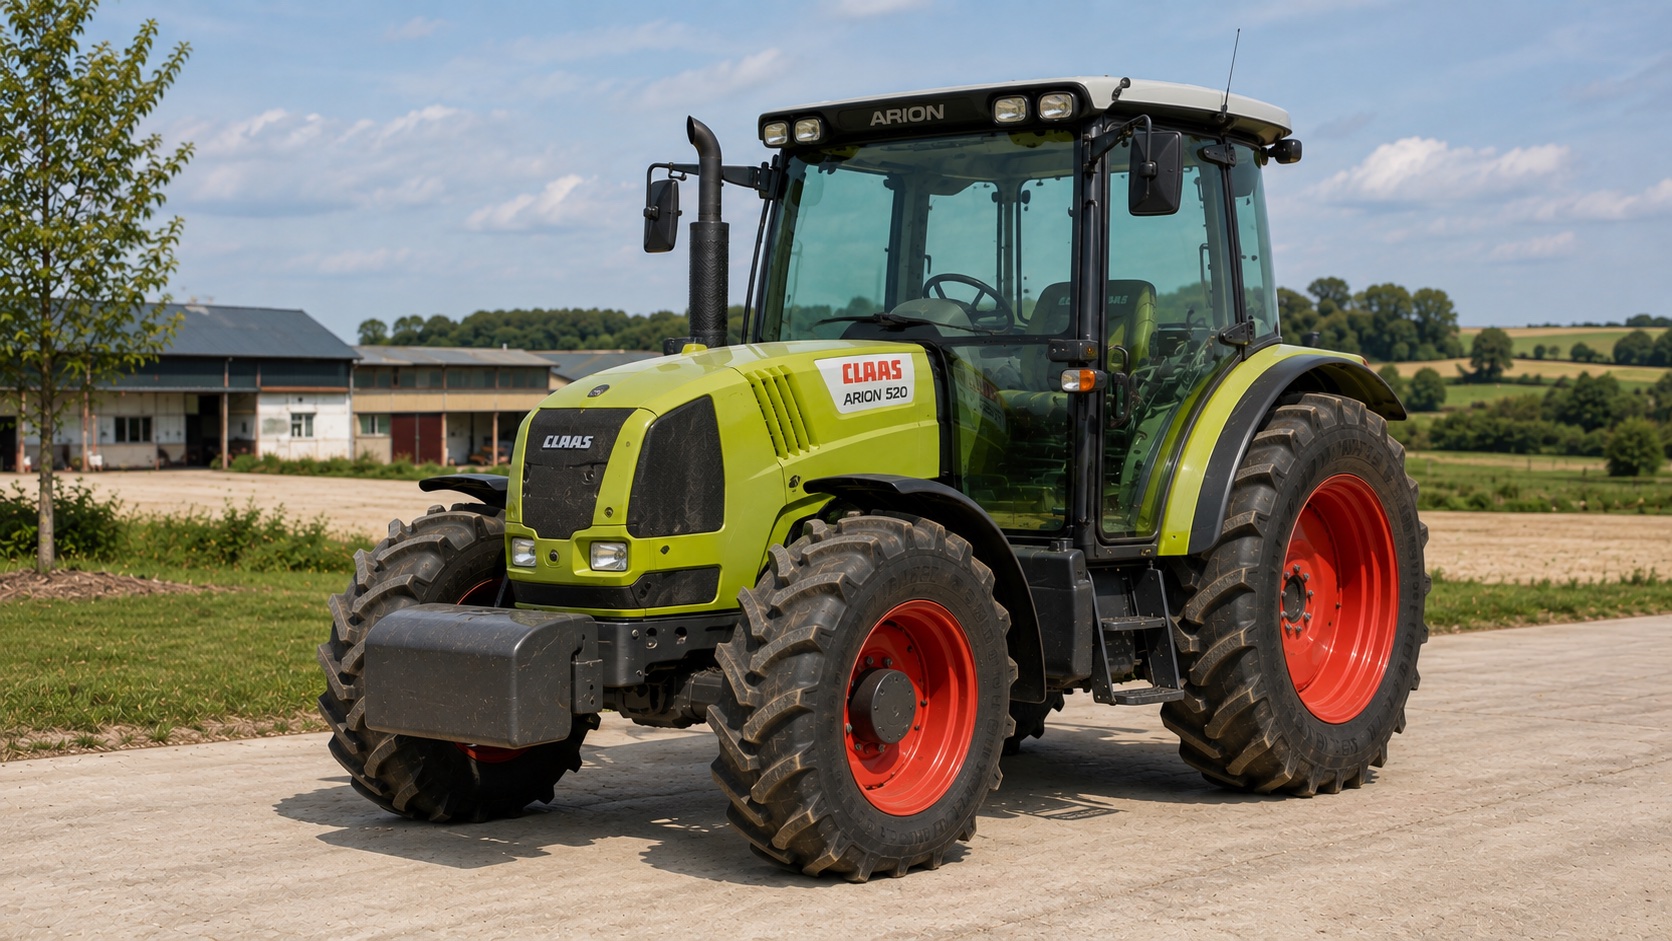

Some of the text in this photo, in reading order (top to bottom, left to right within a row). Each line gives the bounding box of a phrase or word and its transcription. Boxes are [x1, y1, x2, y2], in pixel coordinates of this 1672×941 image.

[870, 104, 944, 126] ARION
[842, 360, 902, 384] CLAAS
[843, 386, 908, 406] ARION 520
[542, 435, 594, 449] CLAAS
